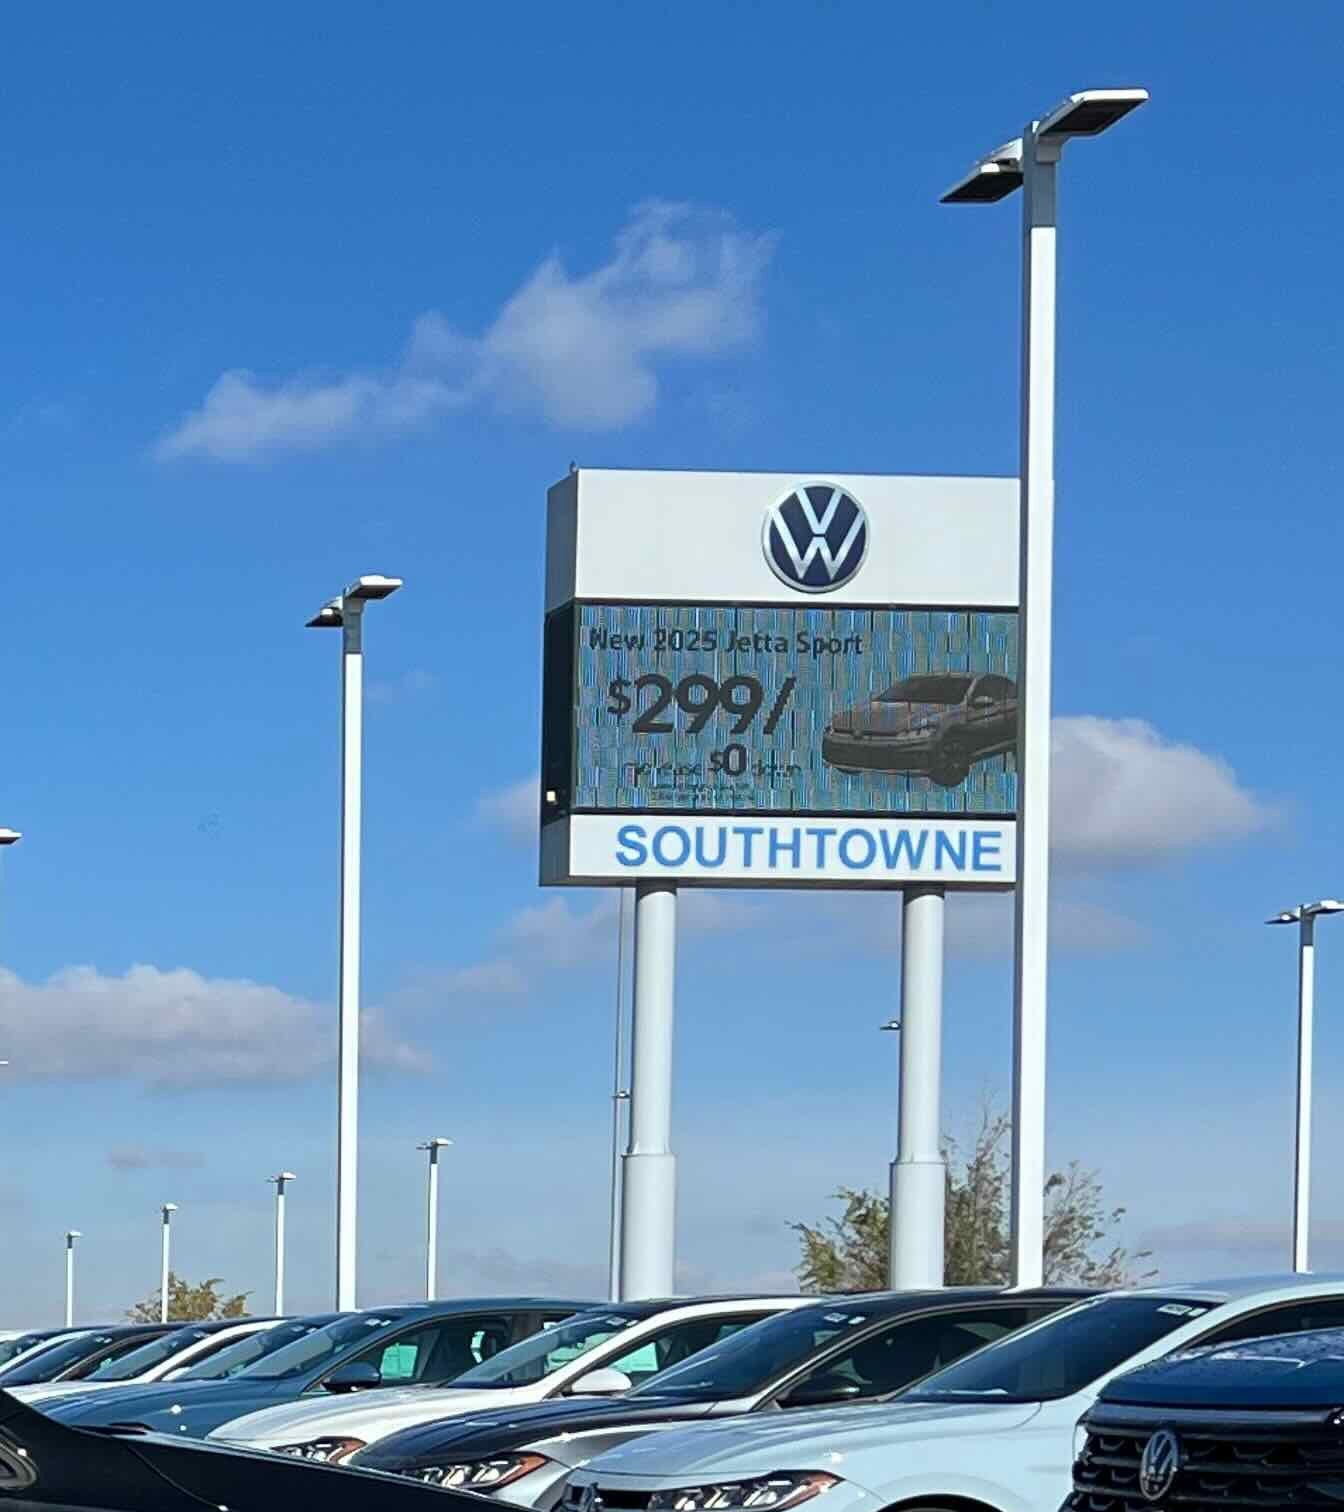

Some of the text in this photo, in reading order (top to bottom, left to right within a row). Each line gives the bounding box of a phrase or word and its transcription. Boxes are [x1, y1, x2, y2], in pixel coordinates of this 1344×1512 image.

[762, 481, 869, 593] VW
[588, 628, 864, 659] New 2025 Jetta Sport
[607, 672, 797, 735] $299/
[615, 824, 1003, 872] SOUTHTOWNE
